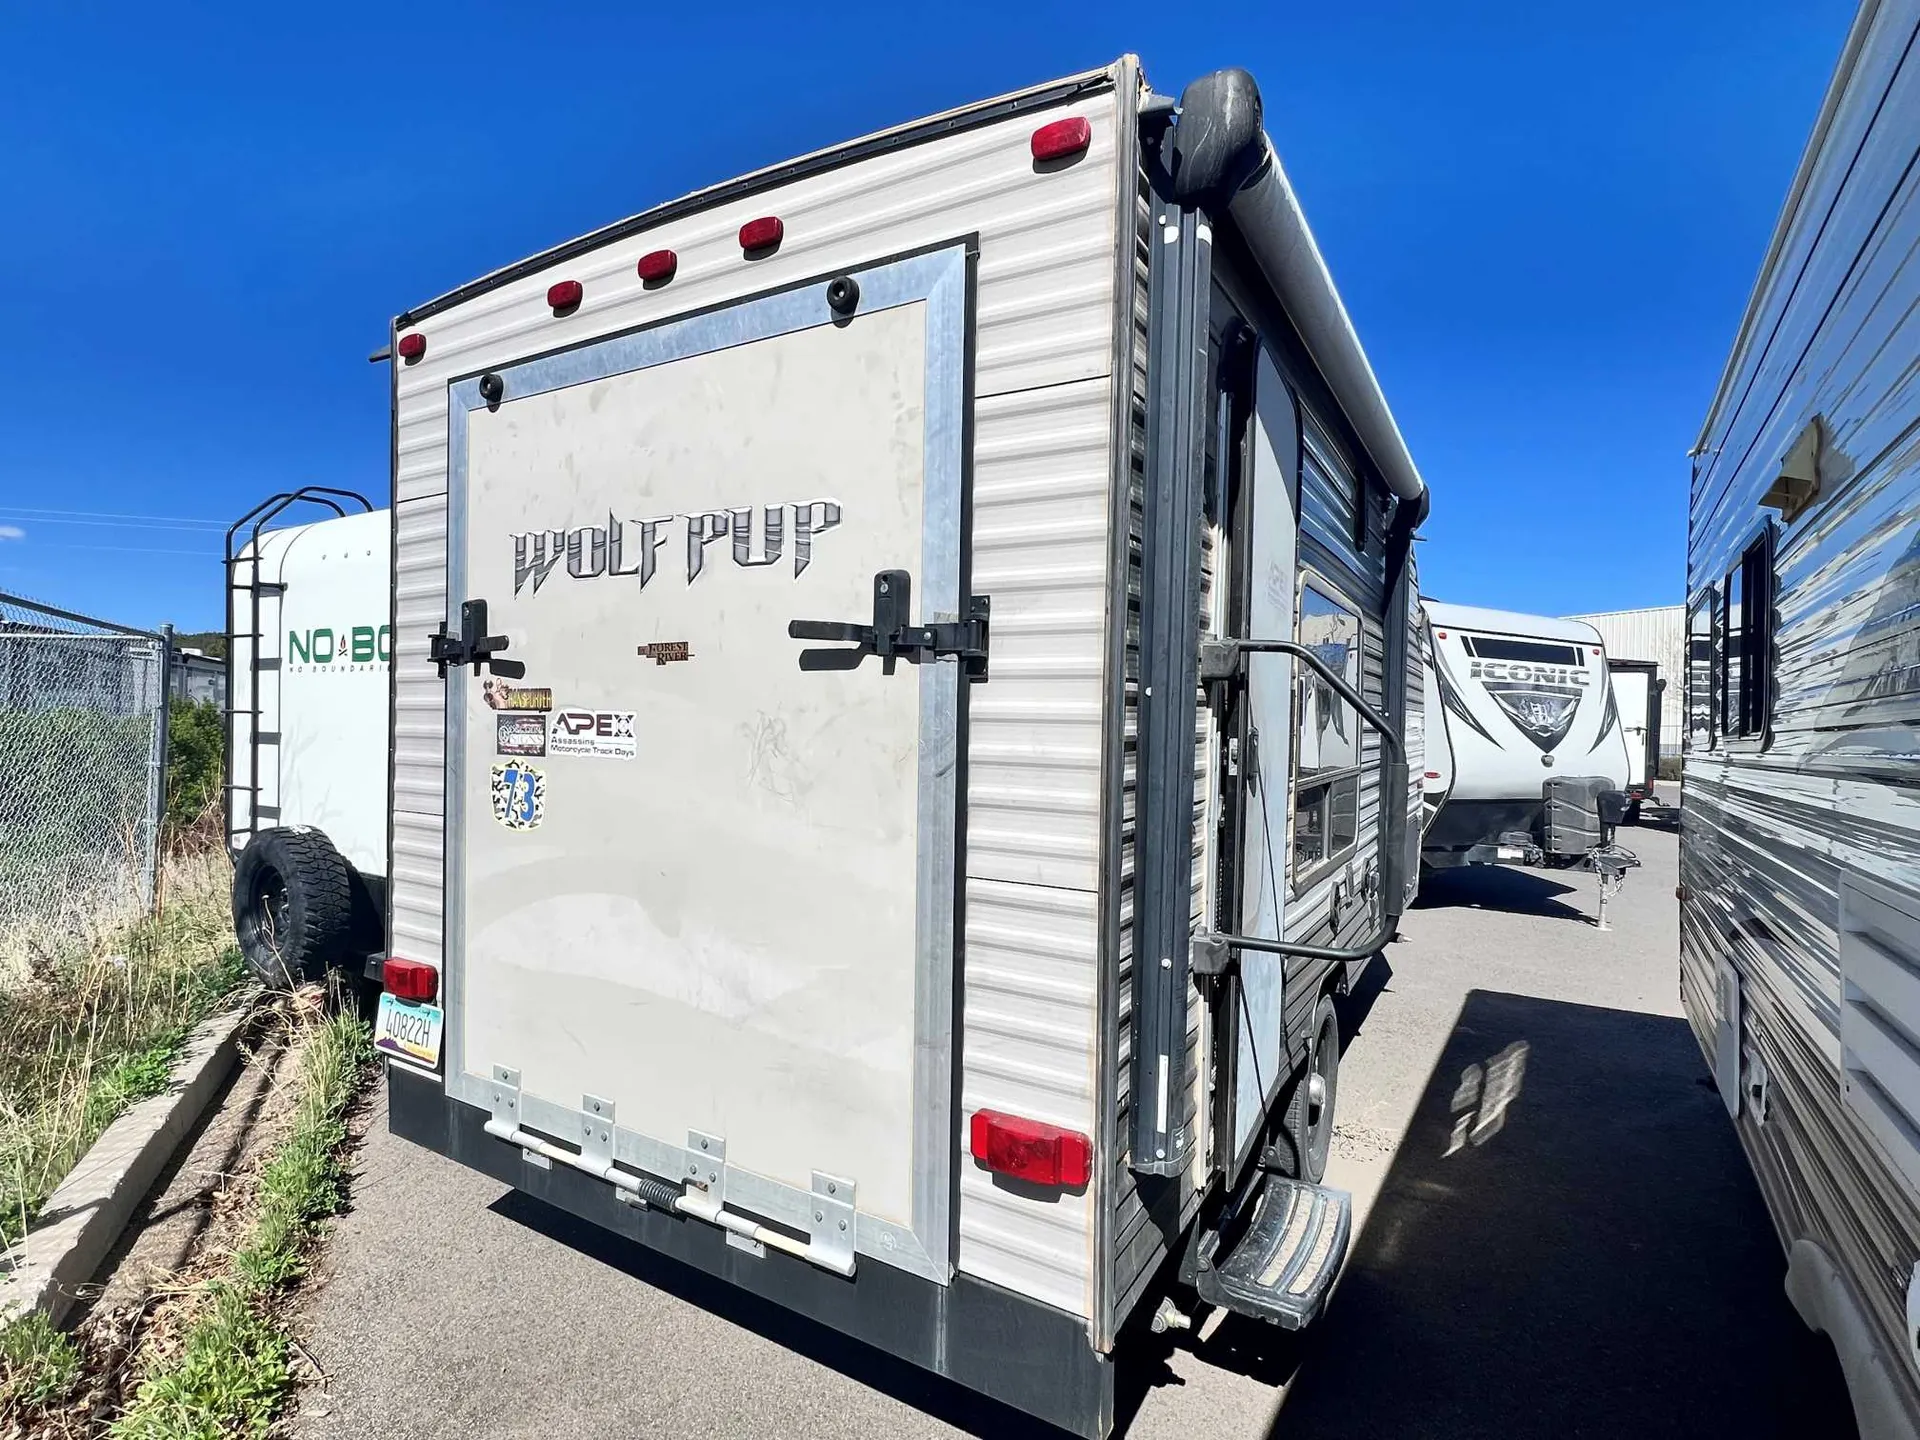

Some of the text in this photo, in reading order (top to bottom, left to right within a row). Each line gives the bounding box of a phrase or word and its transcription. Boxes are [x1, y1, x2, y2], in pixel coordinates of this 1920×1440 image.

[509, 496, 844, 600] WOLF PUP
[648, 642, 687, 655] FOREST
[657, 651, 687, 665] RIVER
[312, 665, 390, 673] BOUNDARI
[1470, 661, 1590, 686] ICONIC
[552, 713, 635, 738] APEX
[551, 745, 591, 754] Motorcycle
[615, 748, 635, 757] Days
[504, 769, 535, 821] 73
[386, 1009, 431, 1048] 40822H
